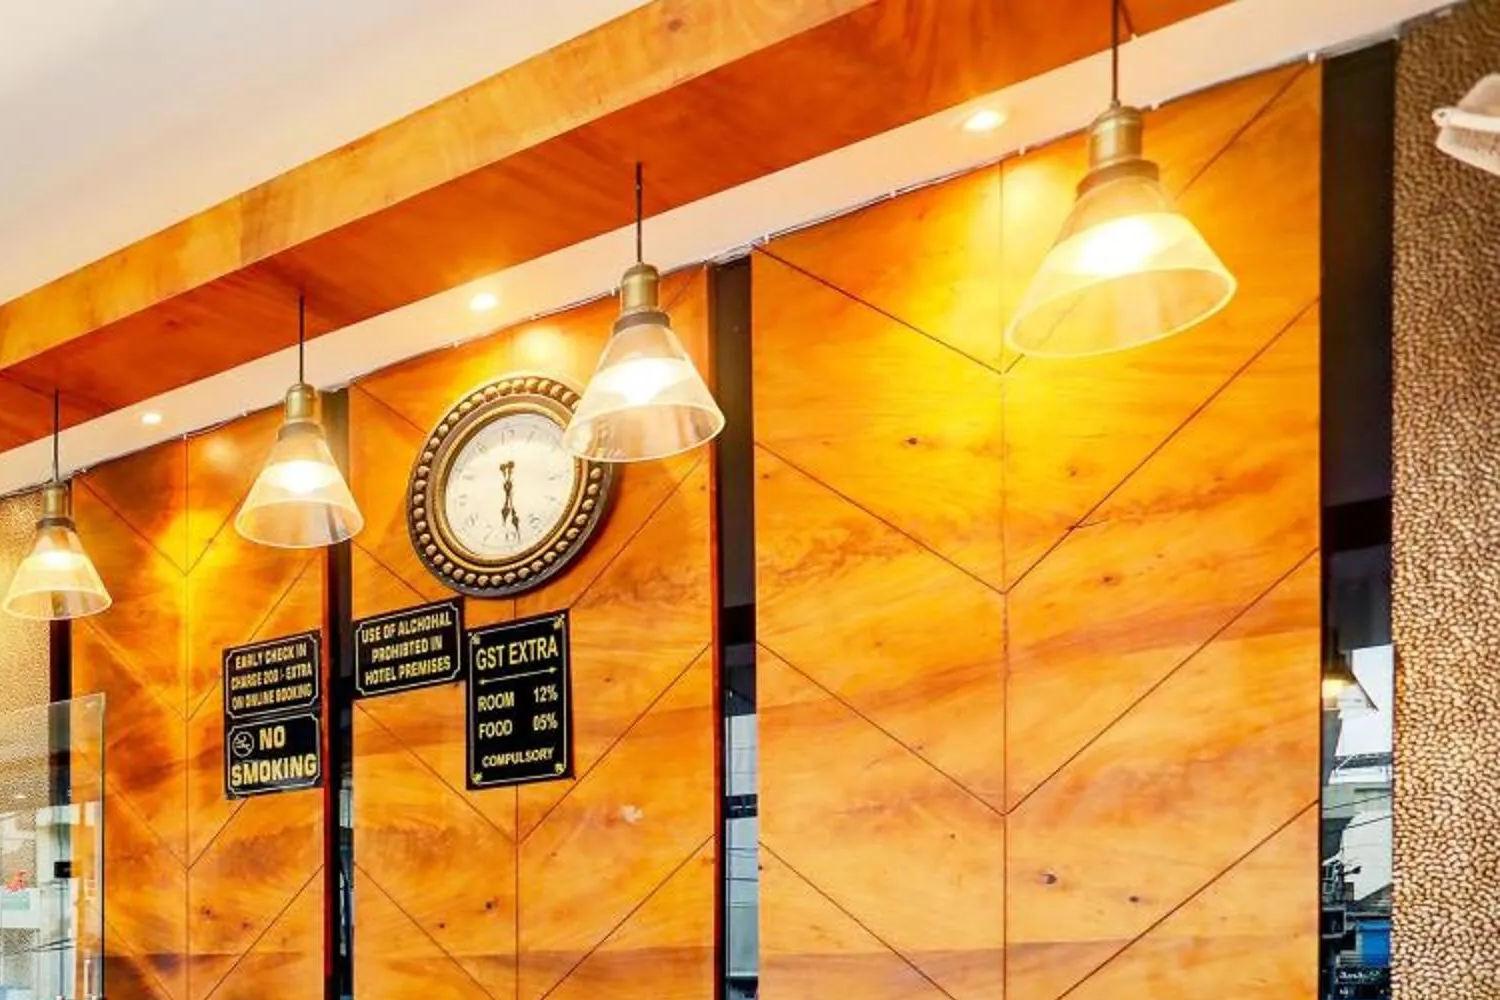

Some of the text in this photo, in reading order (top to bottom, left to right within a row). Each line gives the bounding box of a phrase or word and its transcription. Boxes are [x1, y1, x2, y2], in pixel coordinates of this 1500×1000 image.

[361, 625, 381, 644] USE
[383, 623, 396, 639] OF
[430, 635, 443, 651] IN
[235, 652, 263, 670] EARLY
[475, 635, 559, 671] GST EXTRA
[285, 662, 312, 680] EXTRA
[365, 655, 451, 686] HOTEL PREMISES
[477, 684, 558, 712] ROOM 12%
[259, 725, 285, 750] NO
[479, 719, 513, 740] FOOD
[481, 746, 554, 768] COMPULSORY
[231, 753, 317, 786] SMOKING
